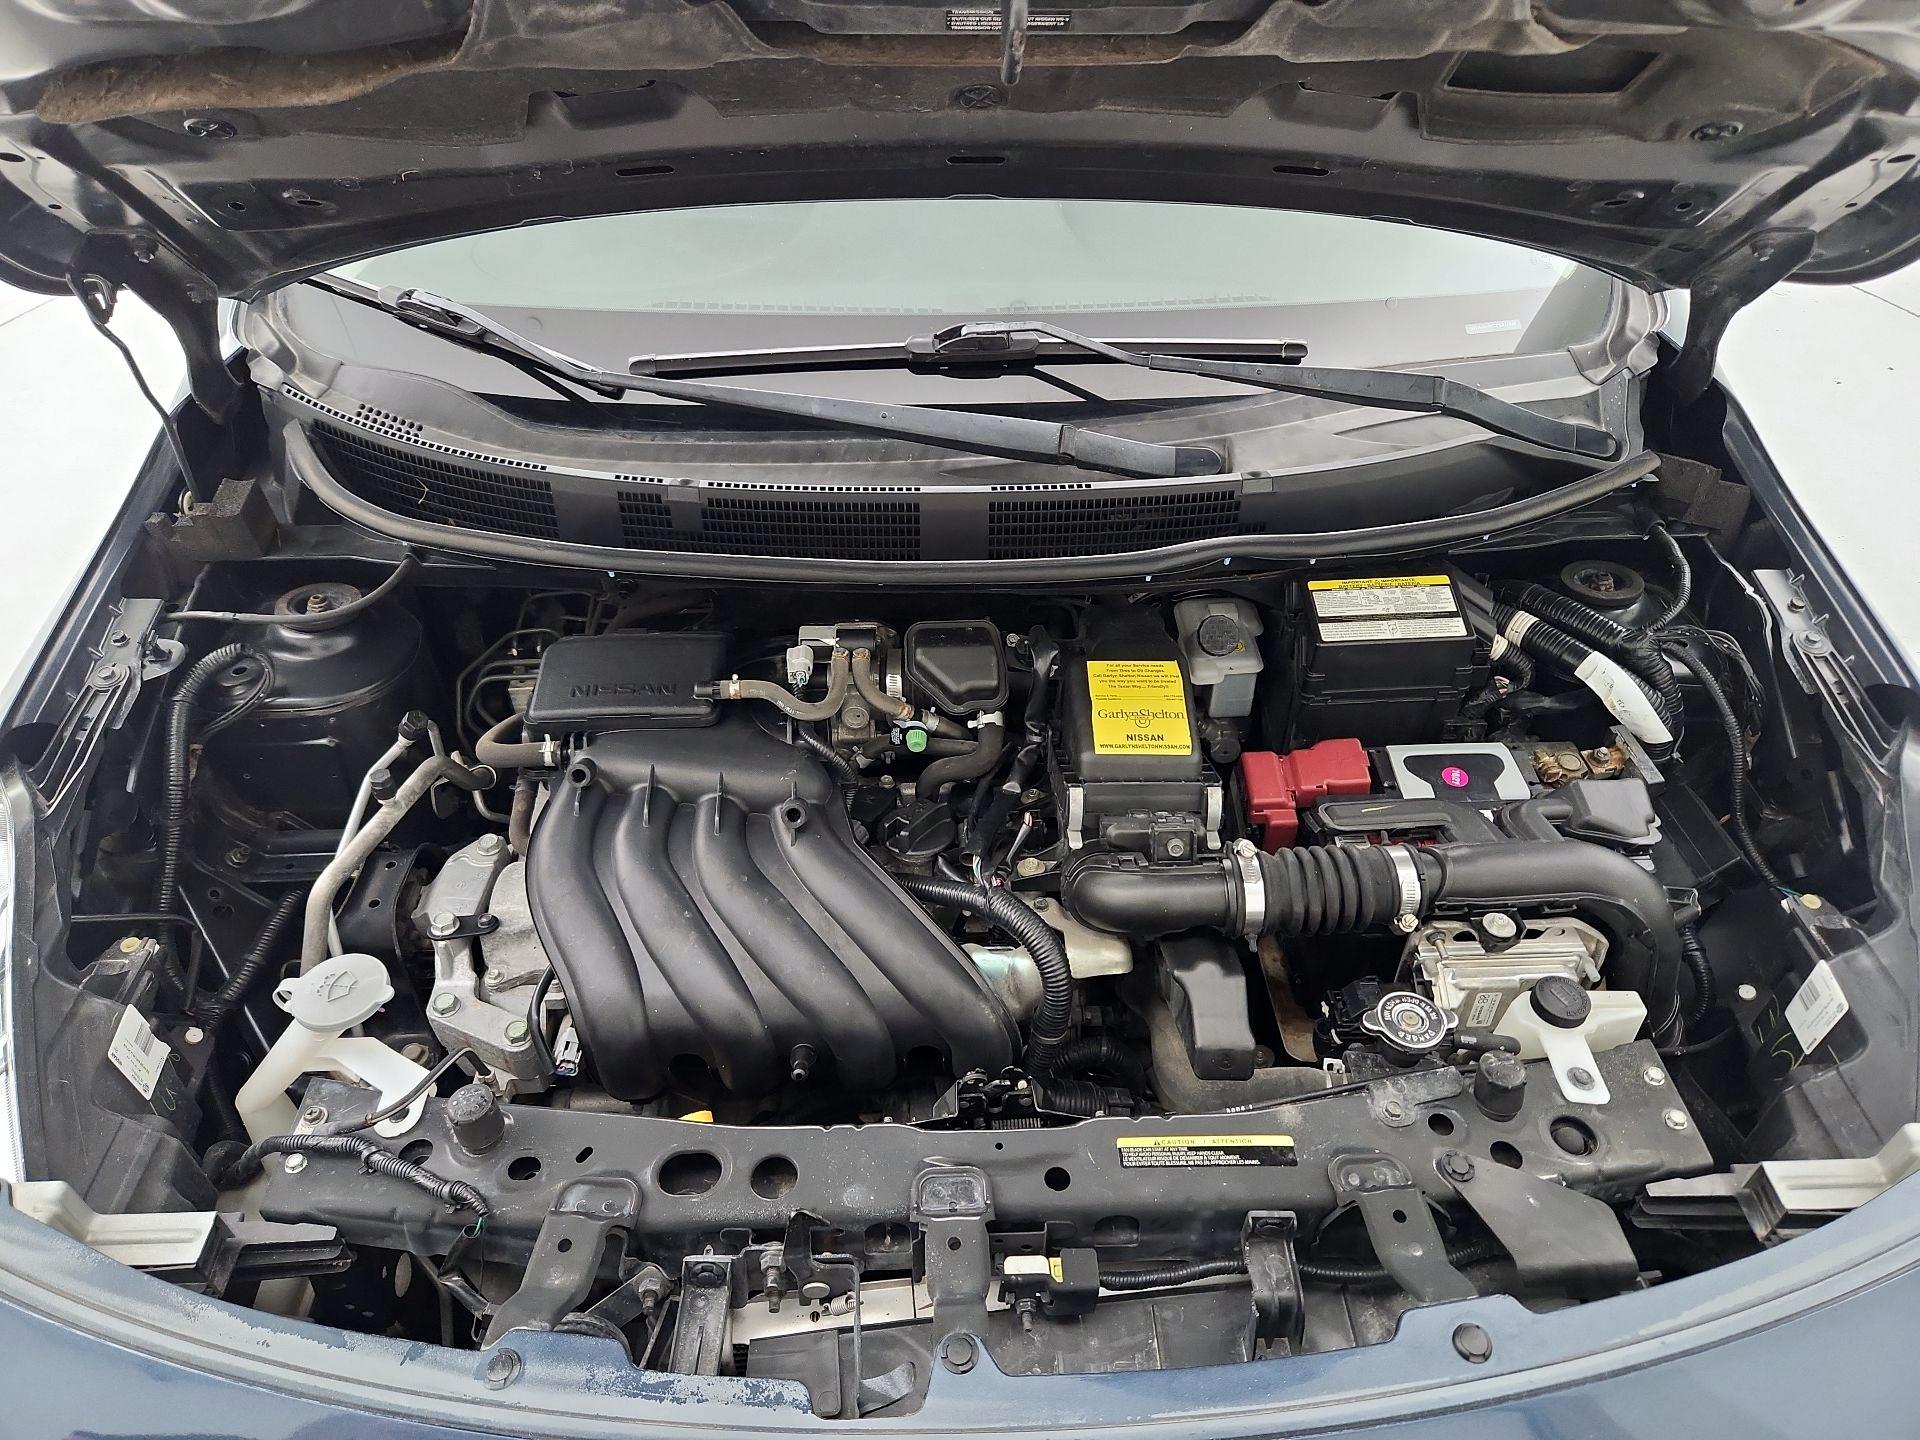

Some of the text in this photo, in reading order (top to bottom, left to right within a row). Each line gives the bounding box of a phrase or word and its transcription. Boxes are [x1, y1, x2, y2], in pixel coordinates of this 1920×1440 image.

[569, 684, 677, 698] NISSAN
[1126, 733, 1164, 742] NISSAN
[1397, 1029, 1436, 1042] DANGER
